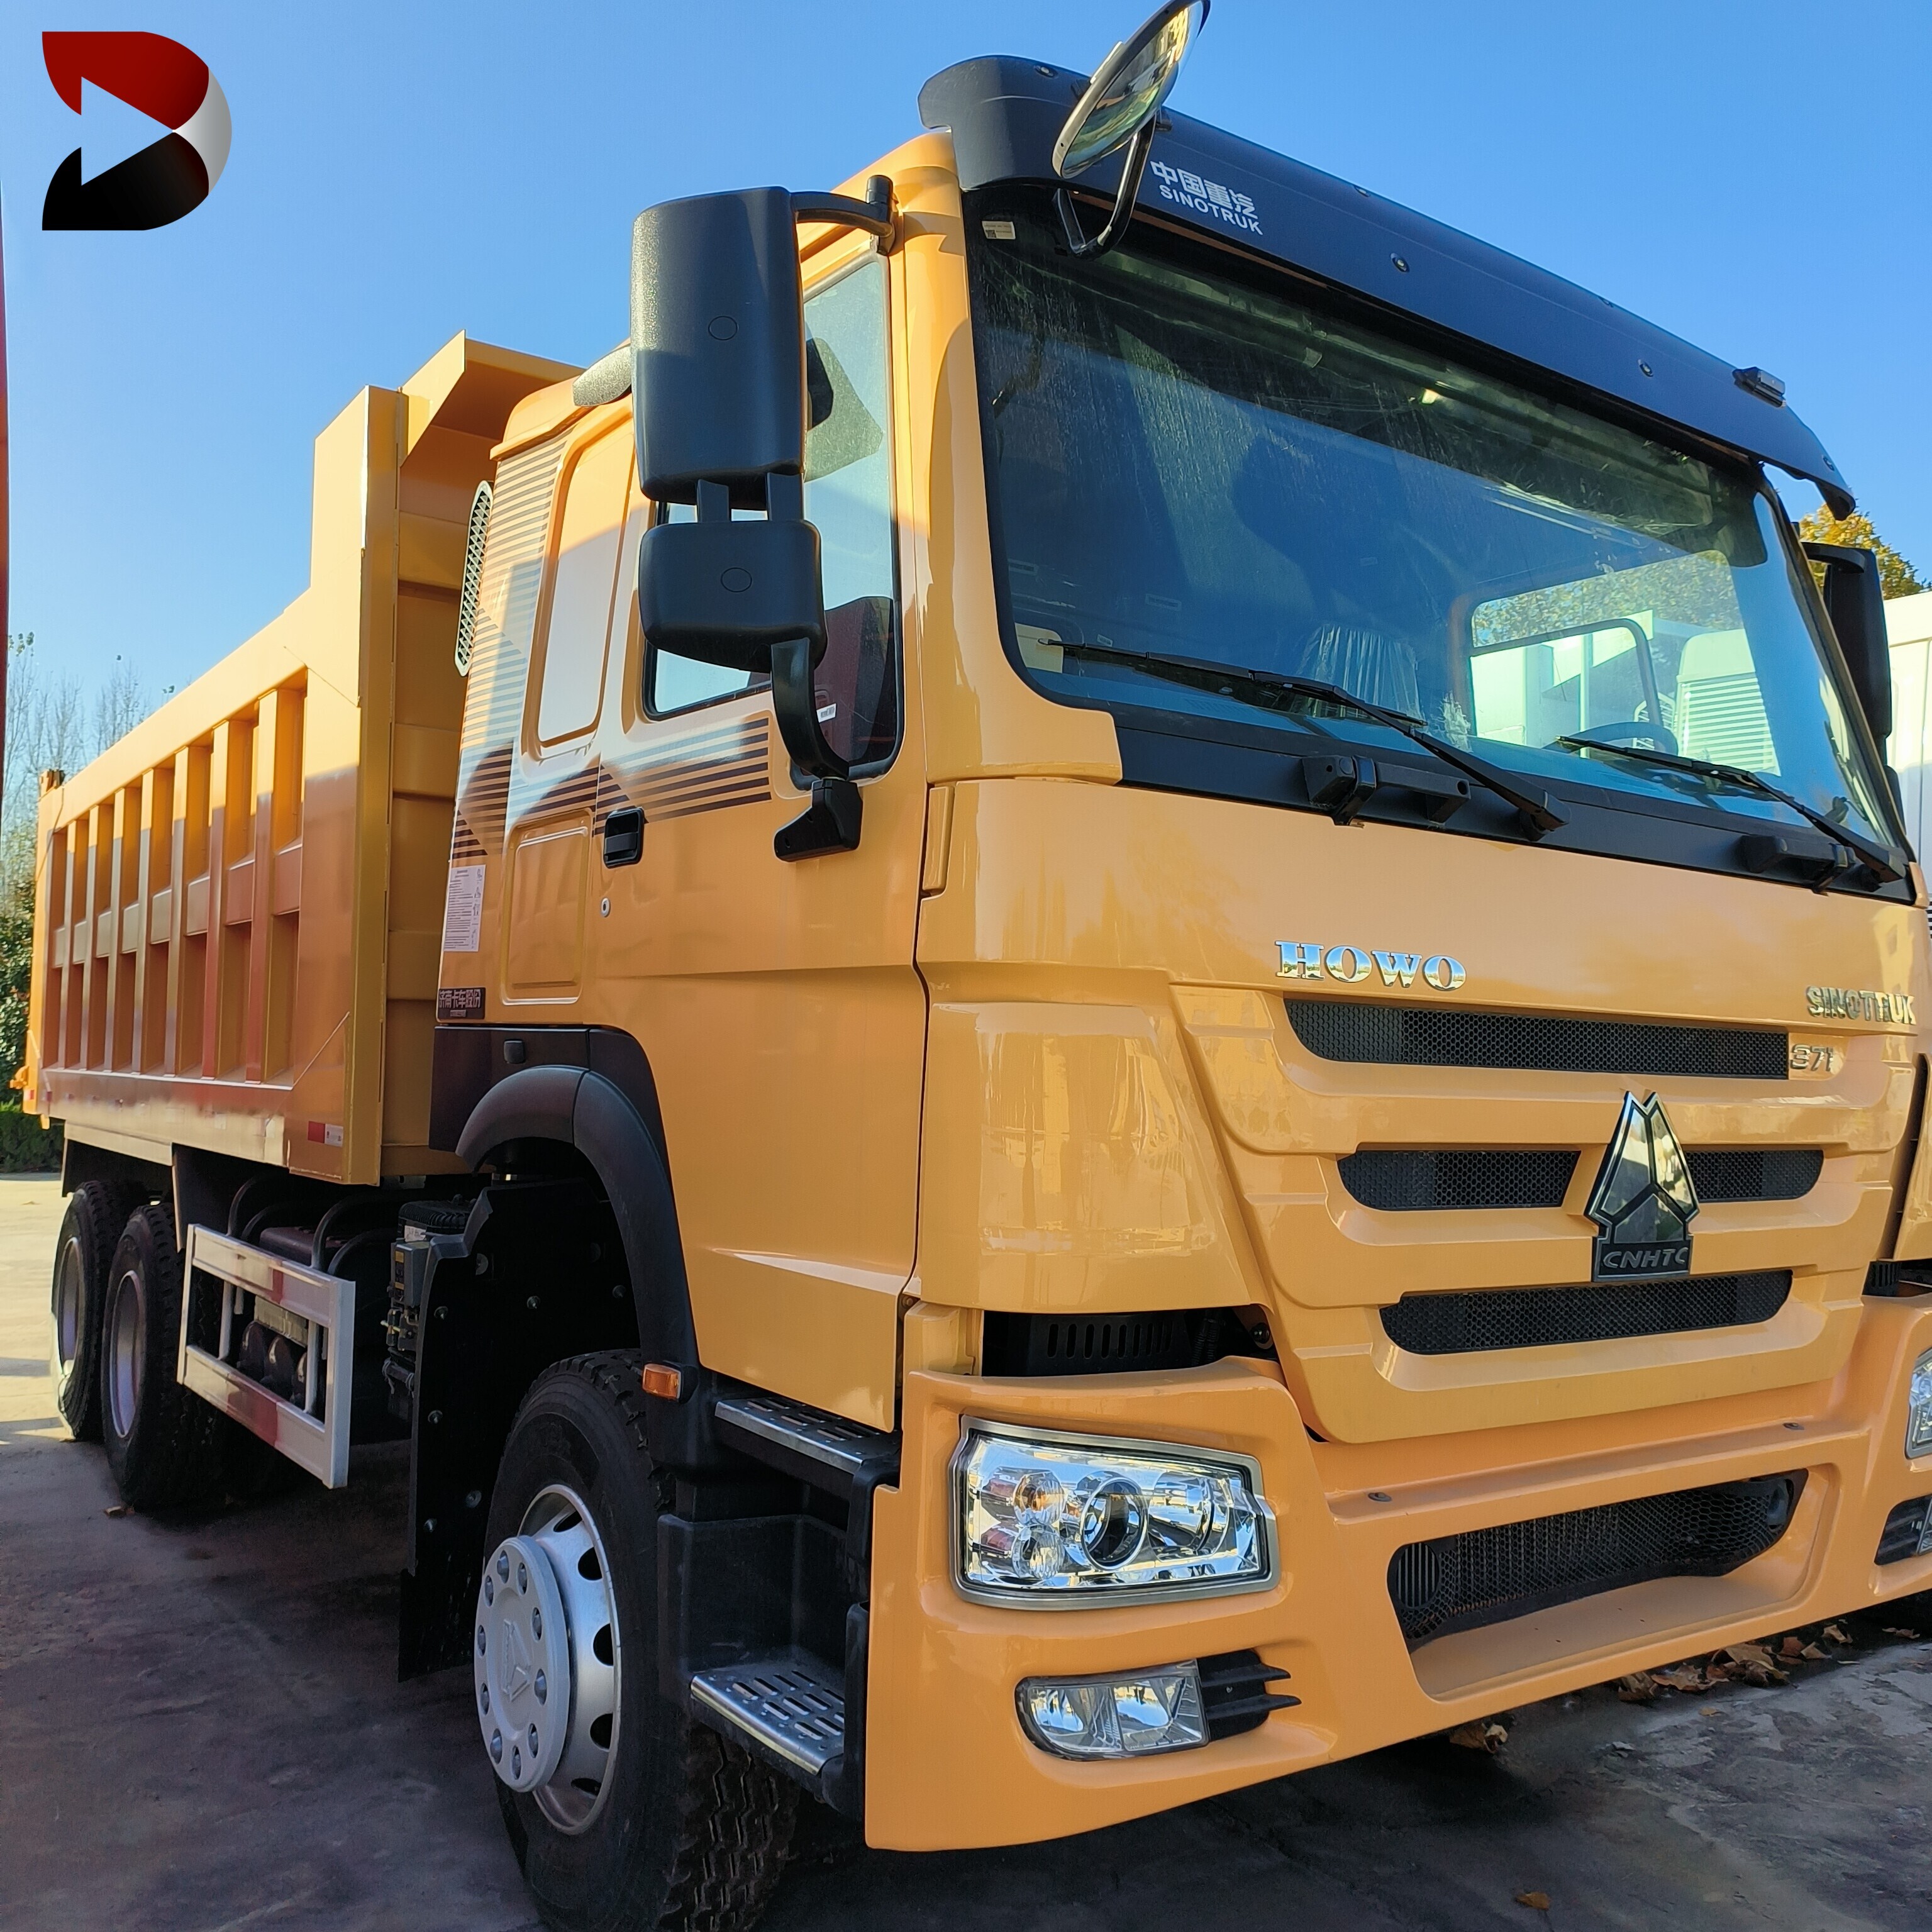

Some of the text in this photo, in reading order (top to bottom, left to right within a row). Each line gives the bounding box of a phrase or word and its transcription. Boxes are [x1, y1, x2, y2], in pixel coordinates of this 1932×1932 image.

[1150, 160, 1258, 219] 中国重汽
[1159, 184, 1263, 236] SINOTRUK
[1275, 941, 1467, 991] HOWO
[1806, 985, 1917, 1025] SINOTRUK
[1790, 1044, 1834, 1072] 371
[1603, 1247, 1689, 1269] CNHTC
